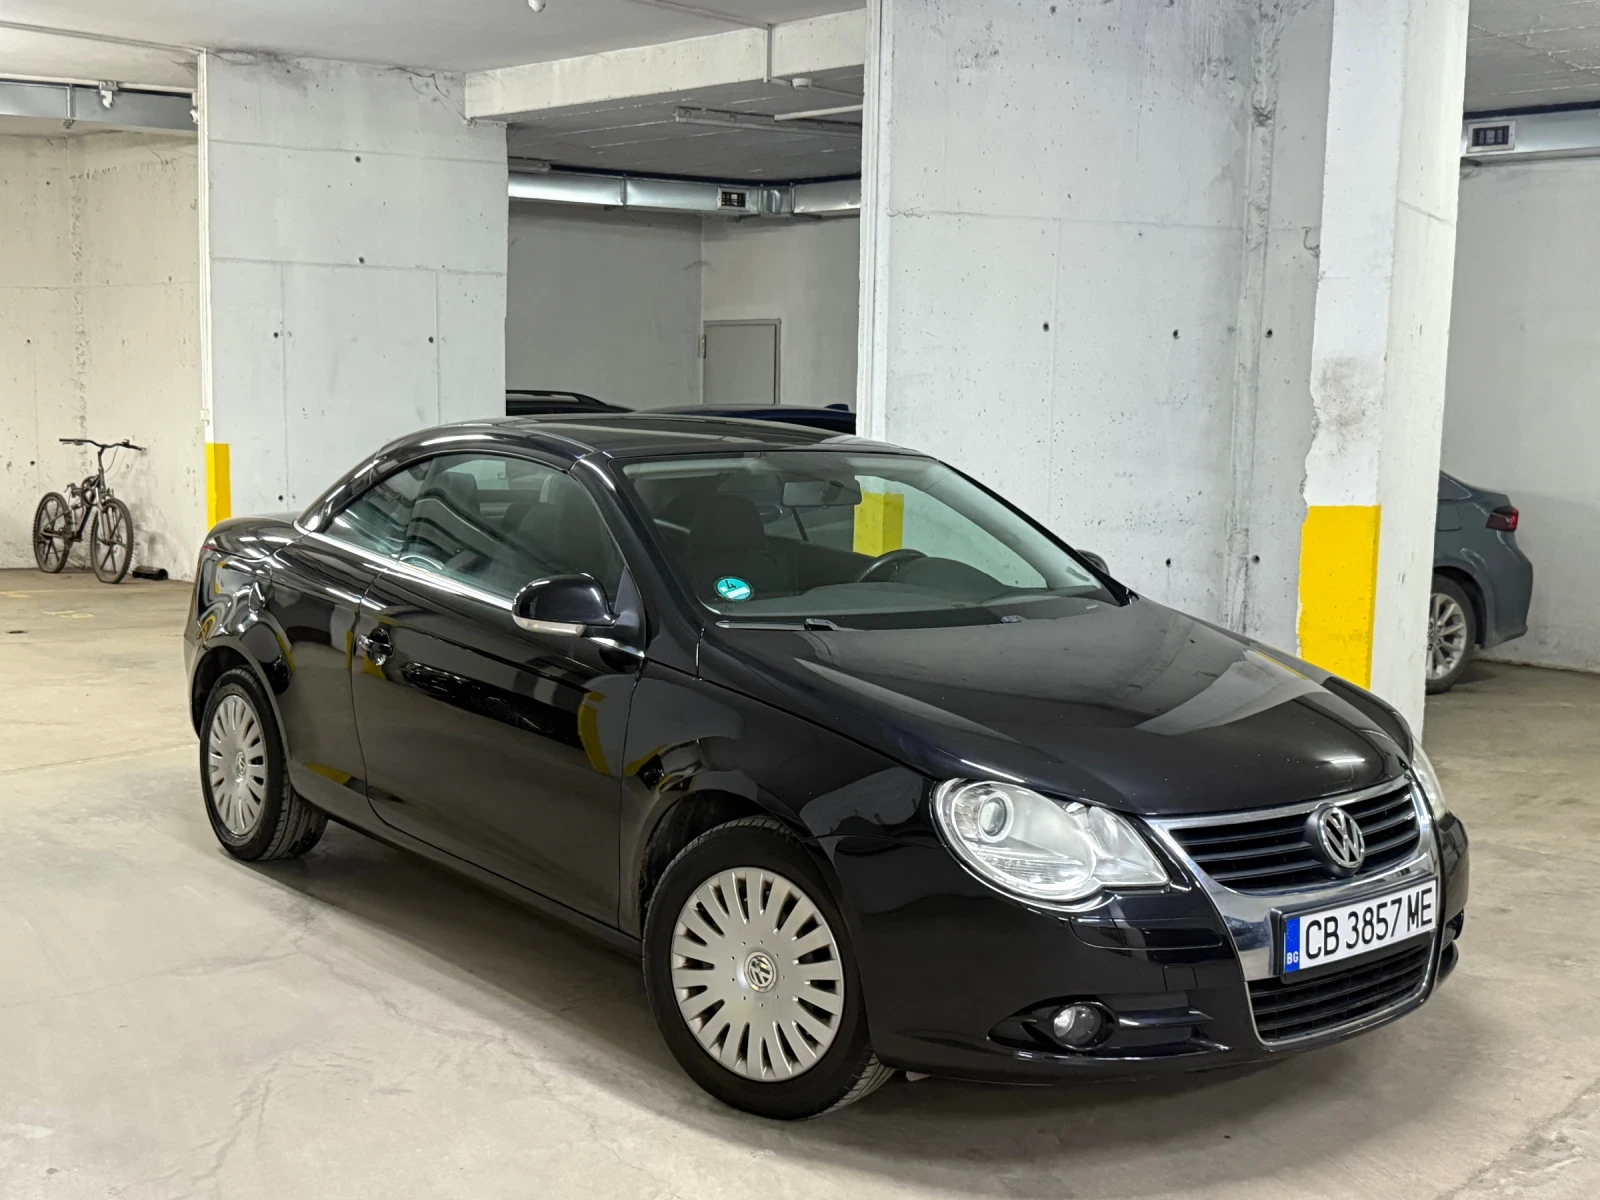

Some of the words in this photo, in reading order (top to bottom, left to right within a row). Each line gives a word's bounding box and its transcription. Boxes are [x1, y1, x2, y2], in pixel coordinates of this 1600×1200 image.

[725, 579, 737, 589] 4
[1319, 808, 1364, 868] VW
[1305, 916, 1340, 960] CB
[1345, 897, 1402, 950] 3857
[1407, 887, 1433, 933] ME
[1286, 951, 1299, 965] BG
